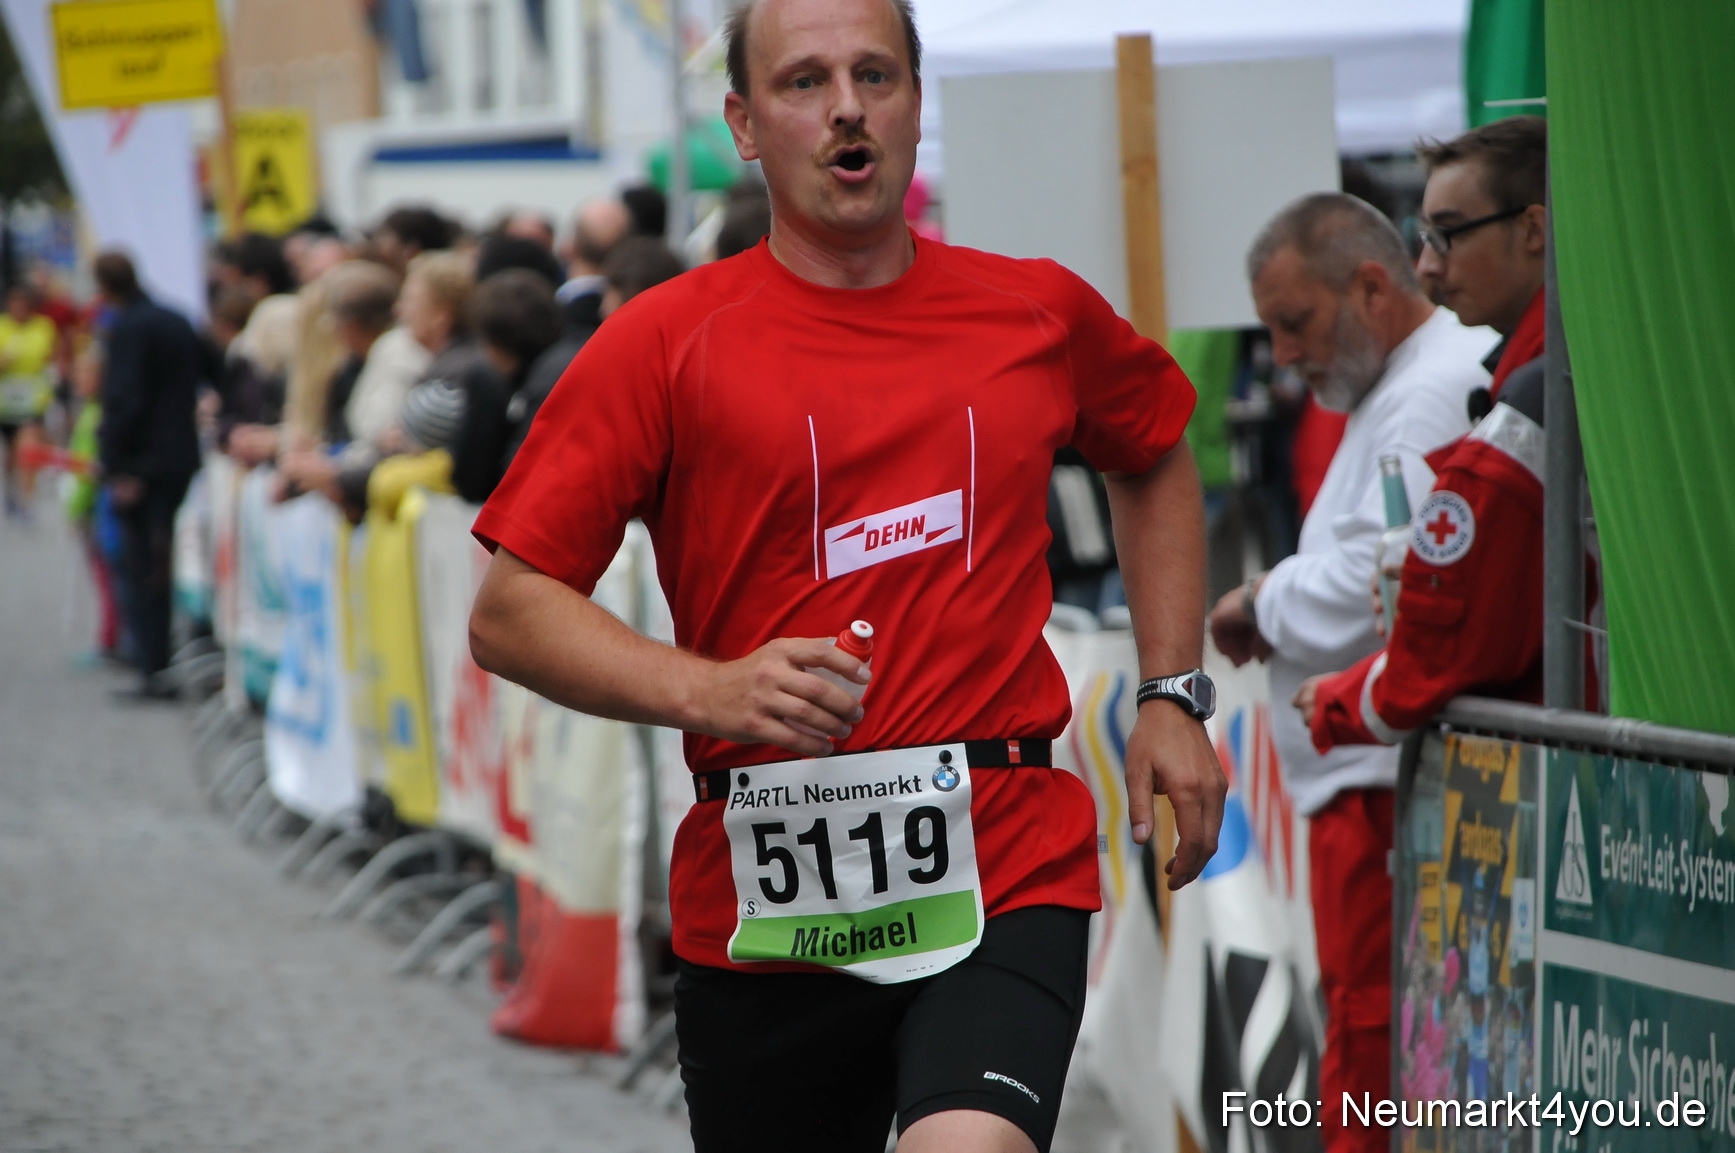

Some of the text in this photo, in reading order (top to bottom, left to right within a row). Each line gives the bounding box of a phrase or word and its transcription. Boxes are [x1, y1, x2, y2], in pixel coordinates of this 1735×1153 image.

[245, 152, 292, 210] A
[864, 514, 926, 552] DEHN
[729, 774, 923, 811] PARTL Neumarkt
[751, 804, 949, 905] 5119
[789, 912, 918, 958] Michael
[1552, 1000, 1623, 1101] Mehr
[983, 1071, 1041, 1104] BROOKS
